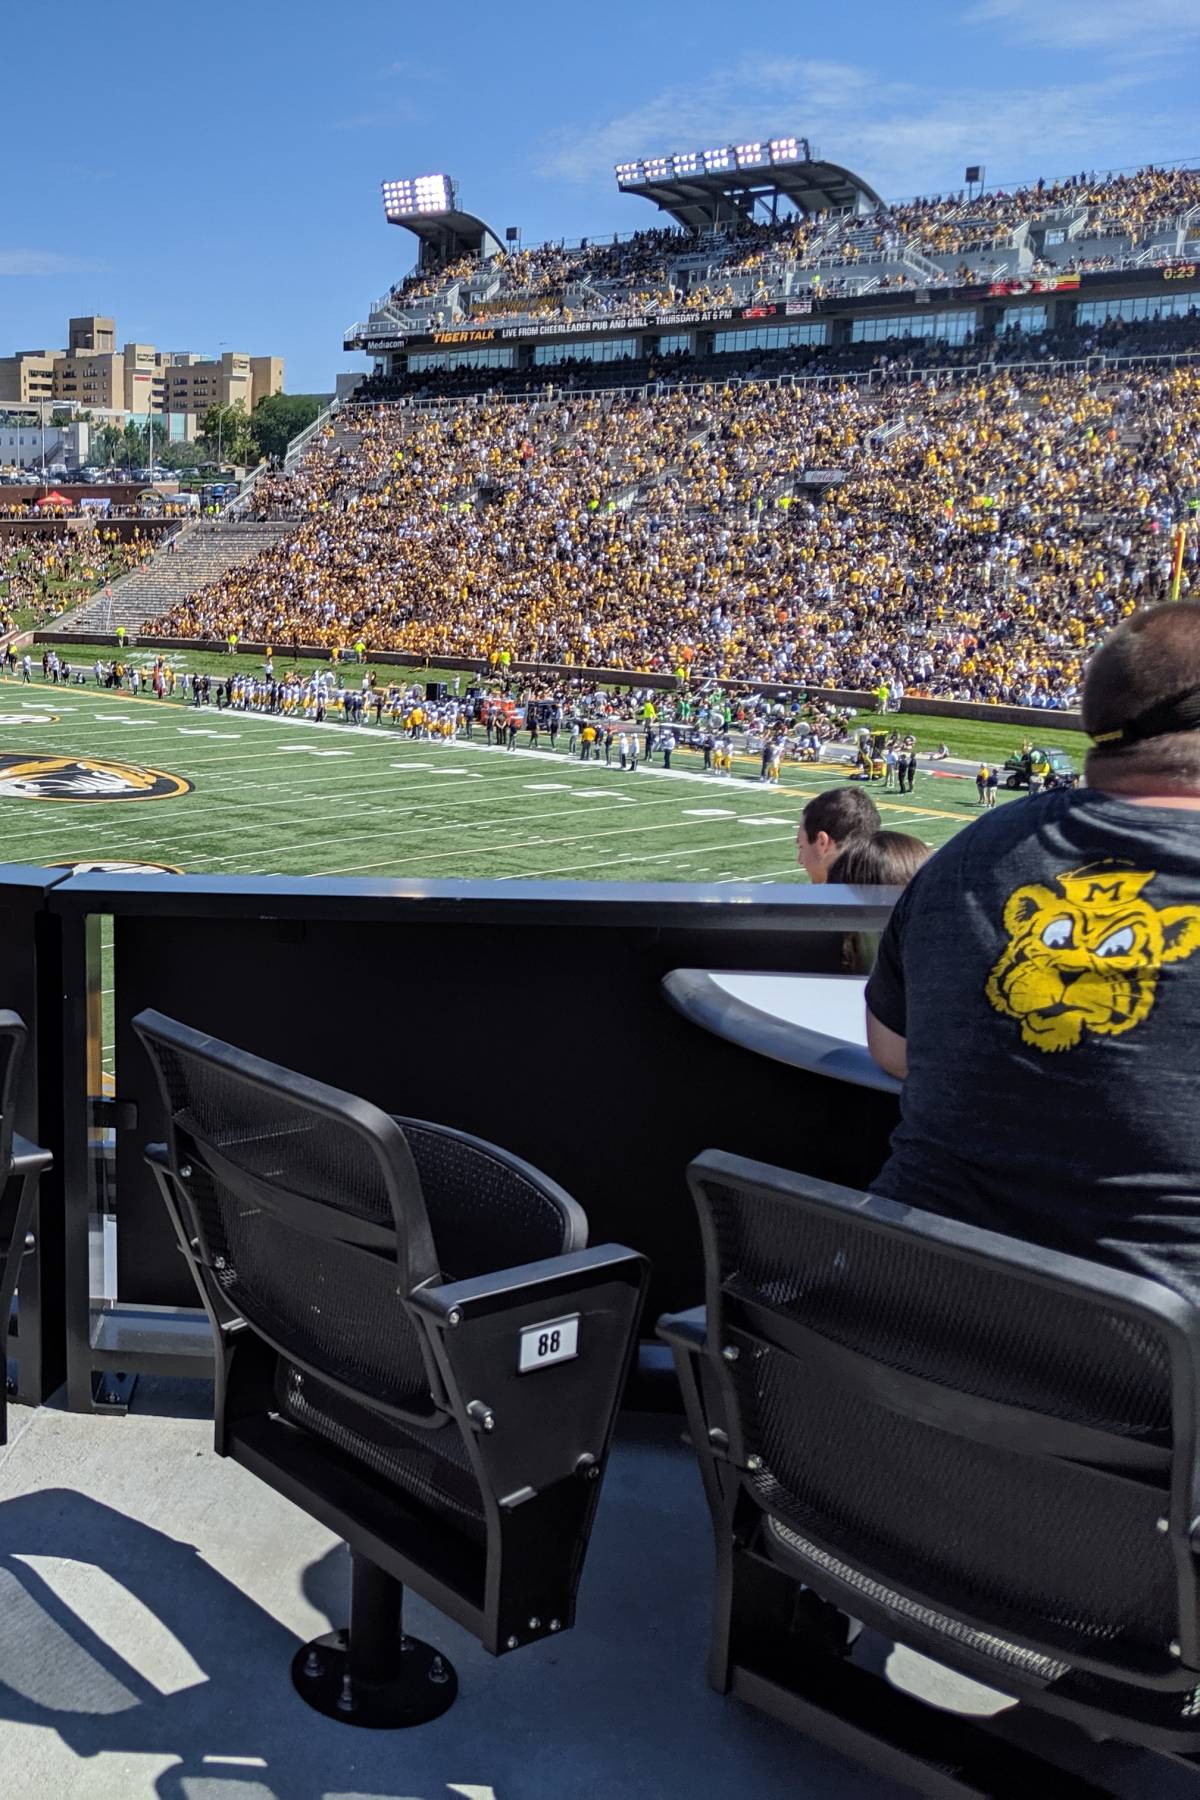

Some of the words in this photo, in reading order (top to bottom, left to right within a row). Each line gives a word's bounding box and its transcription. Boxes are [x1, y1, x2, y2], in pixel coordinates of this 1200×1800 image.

[1163, 264, 1196, 280] 0:23
[433, 331, 469, 344] TIGER
[469, 329, 495, 341] TALK
[502, 329, 517, 338] LIVE
[518, 327, 538, 337] FROM
[540, 322, 590, 335] CHEERLEADER
[592, 320, 608, 331] PUB
[610, 318, 625, 329] AND
[627, 316, 648, 328] GRILL
[656, 312, 700, 325] THURSDAYS
[701, 312, 711, 321] AT
[719, 309, 732, 320] PM
[367, 340, 405, 350] Mediacom
[1083, 881, 1126, 902] M
[538, 1329, 561, 1357] 88
